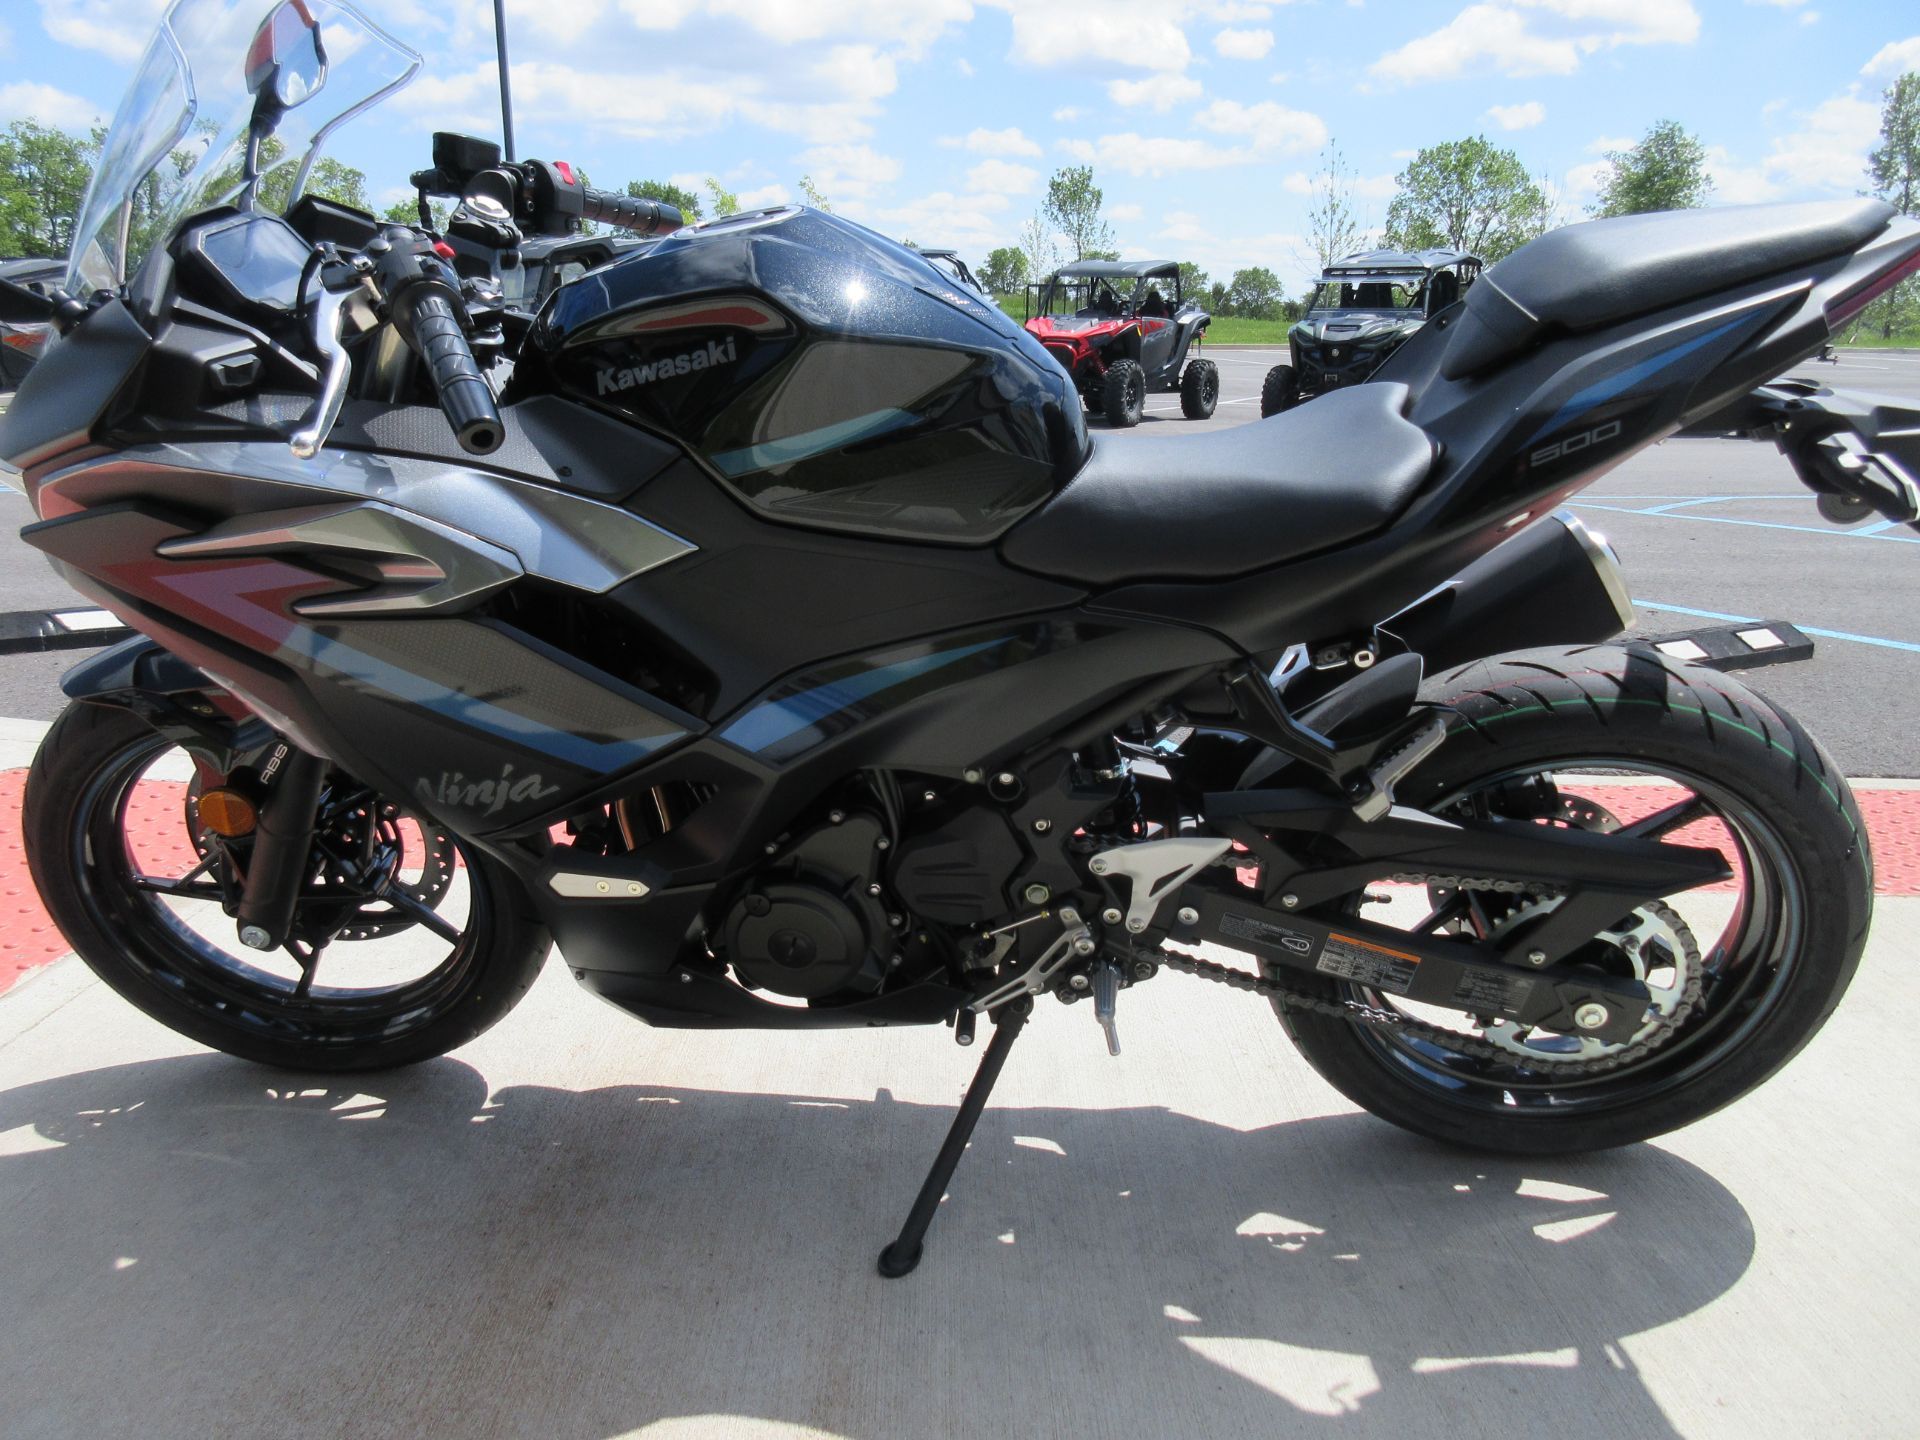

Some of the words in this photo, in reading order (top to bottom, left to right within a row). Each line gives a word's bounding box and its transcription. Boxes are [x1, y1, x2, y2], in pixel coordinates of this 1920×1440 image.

[596, 335, 737, 396] Kawasaki
[1530, 420, 1621, 468] 500
[260, 743, 288, 785] ABS
[414, 763, 561, 818] Ninja
